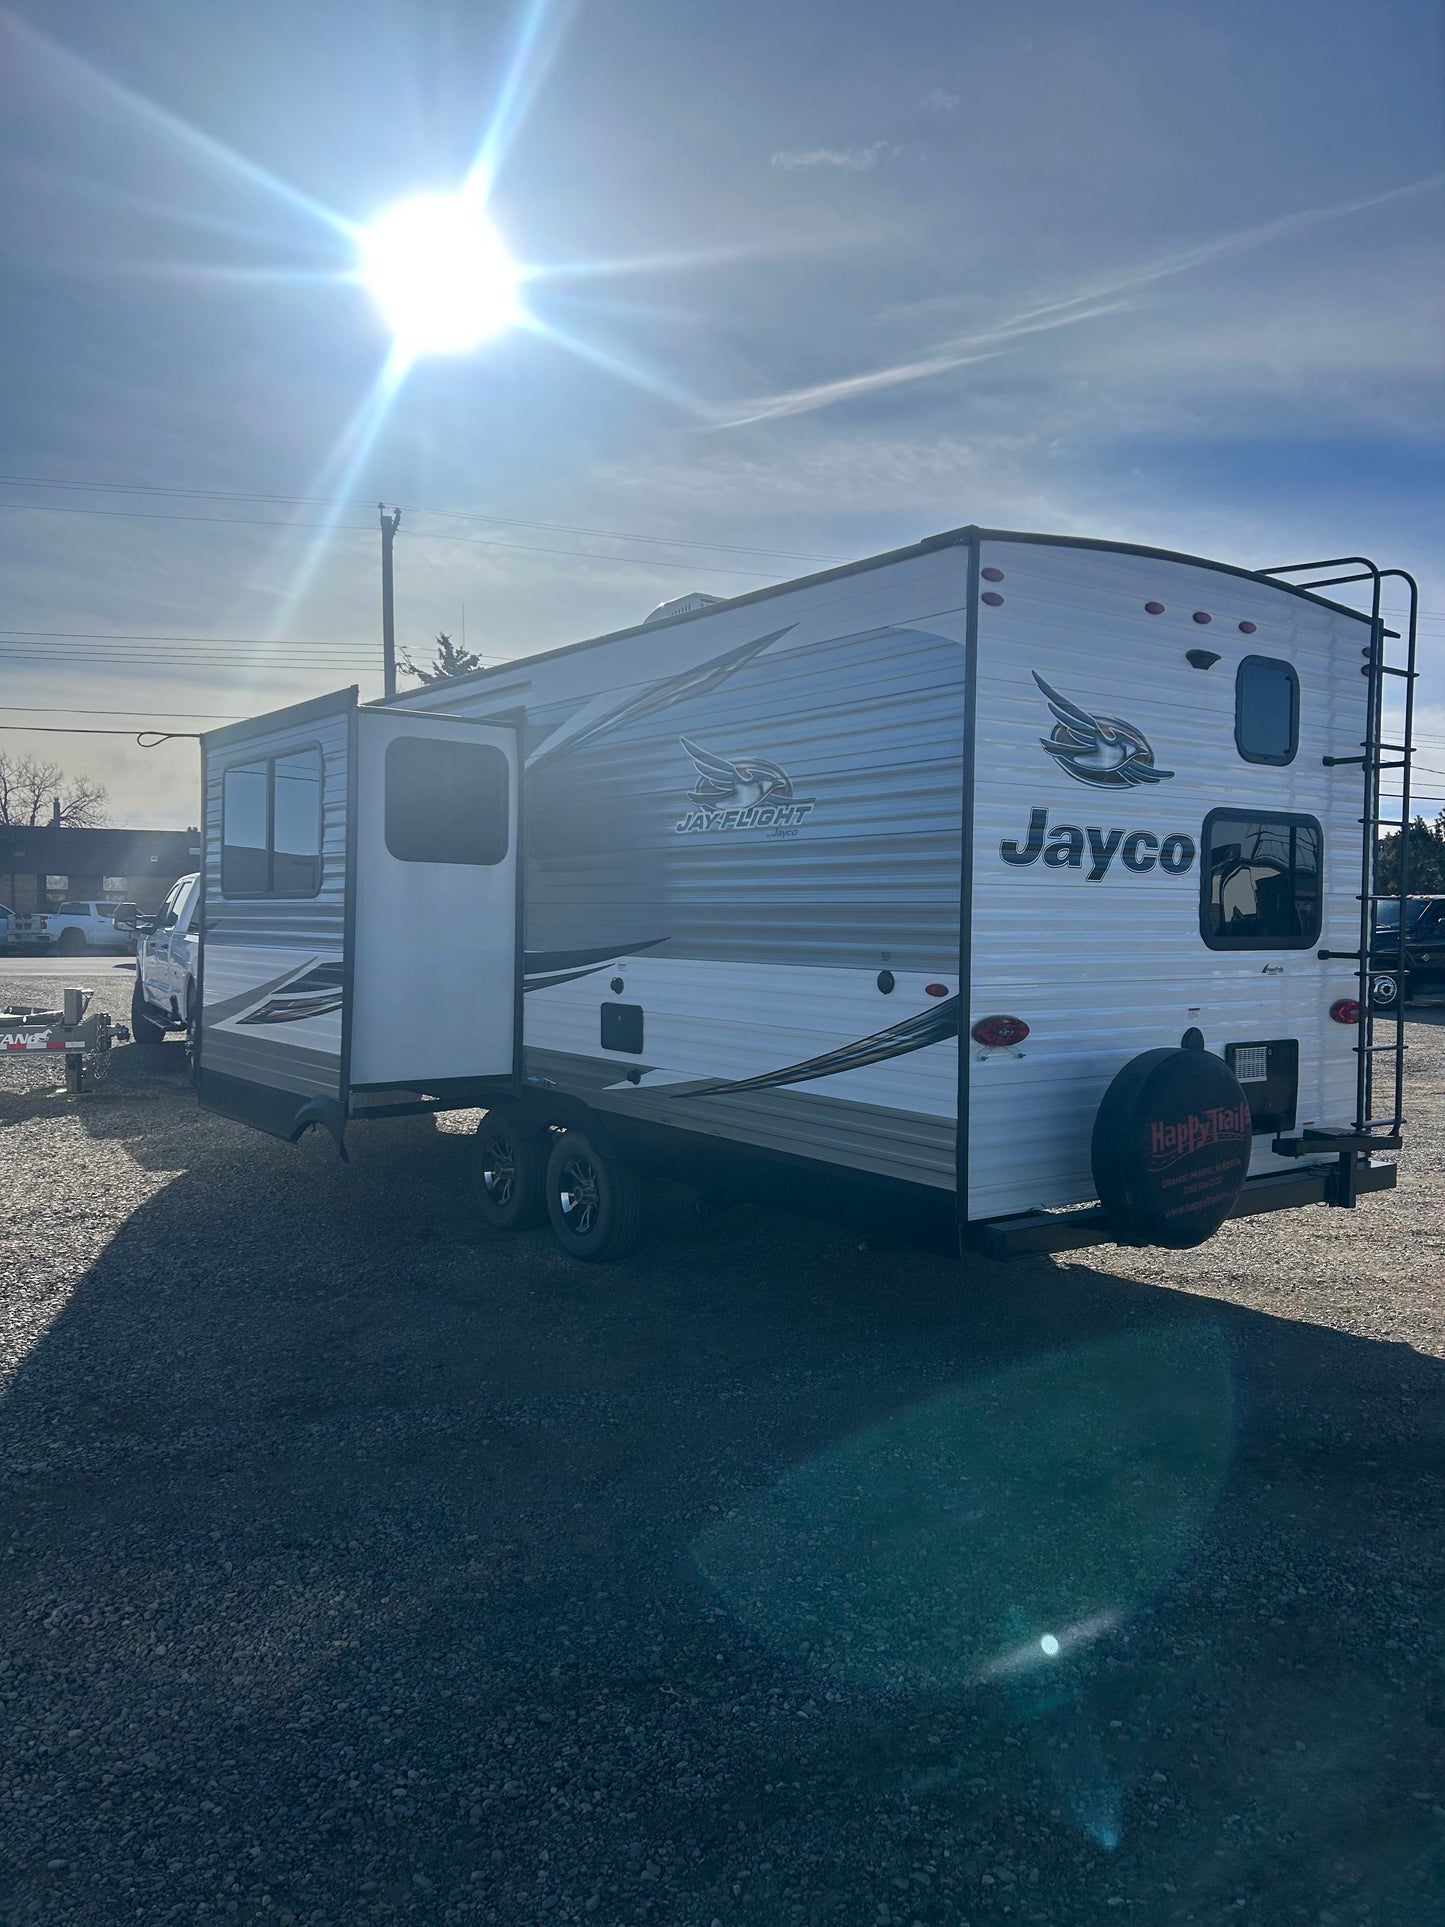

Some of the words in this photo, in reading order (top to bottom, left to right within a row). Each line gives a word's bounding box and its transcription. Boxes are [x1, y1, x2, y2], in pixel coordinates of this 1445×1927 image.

[719, 804, 816, 830] FLIGHT
[774, 829, 798, 838] Jayco
[999, 805, 1197, 883] Jayco
